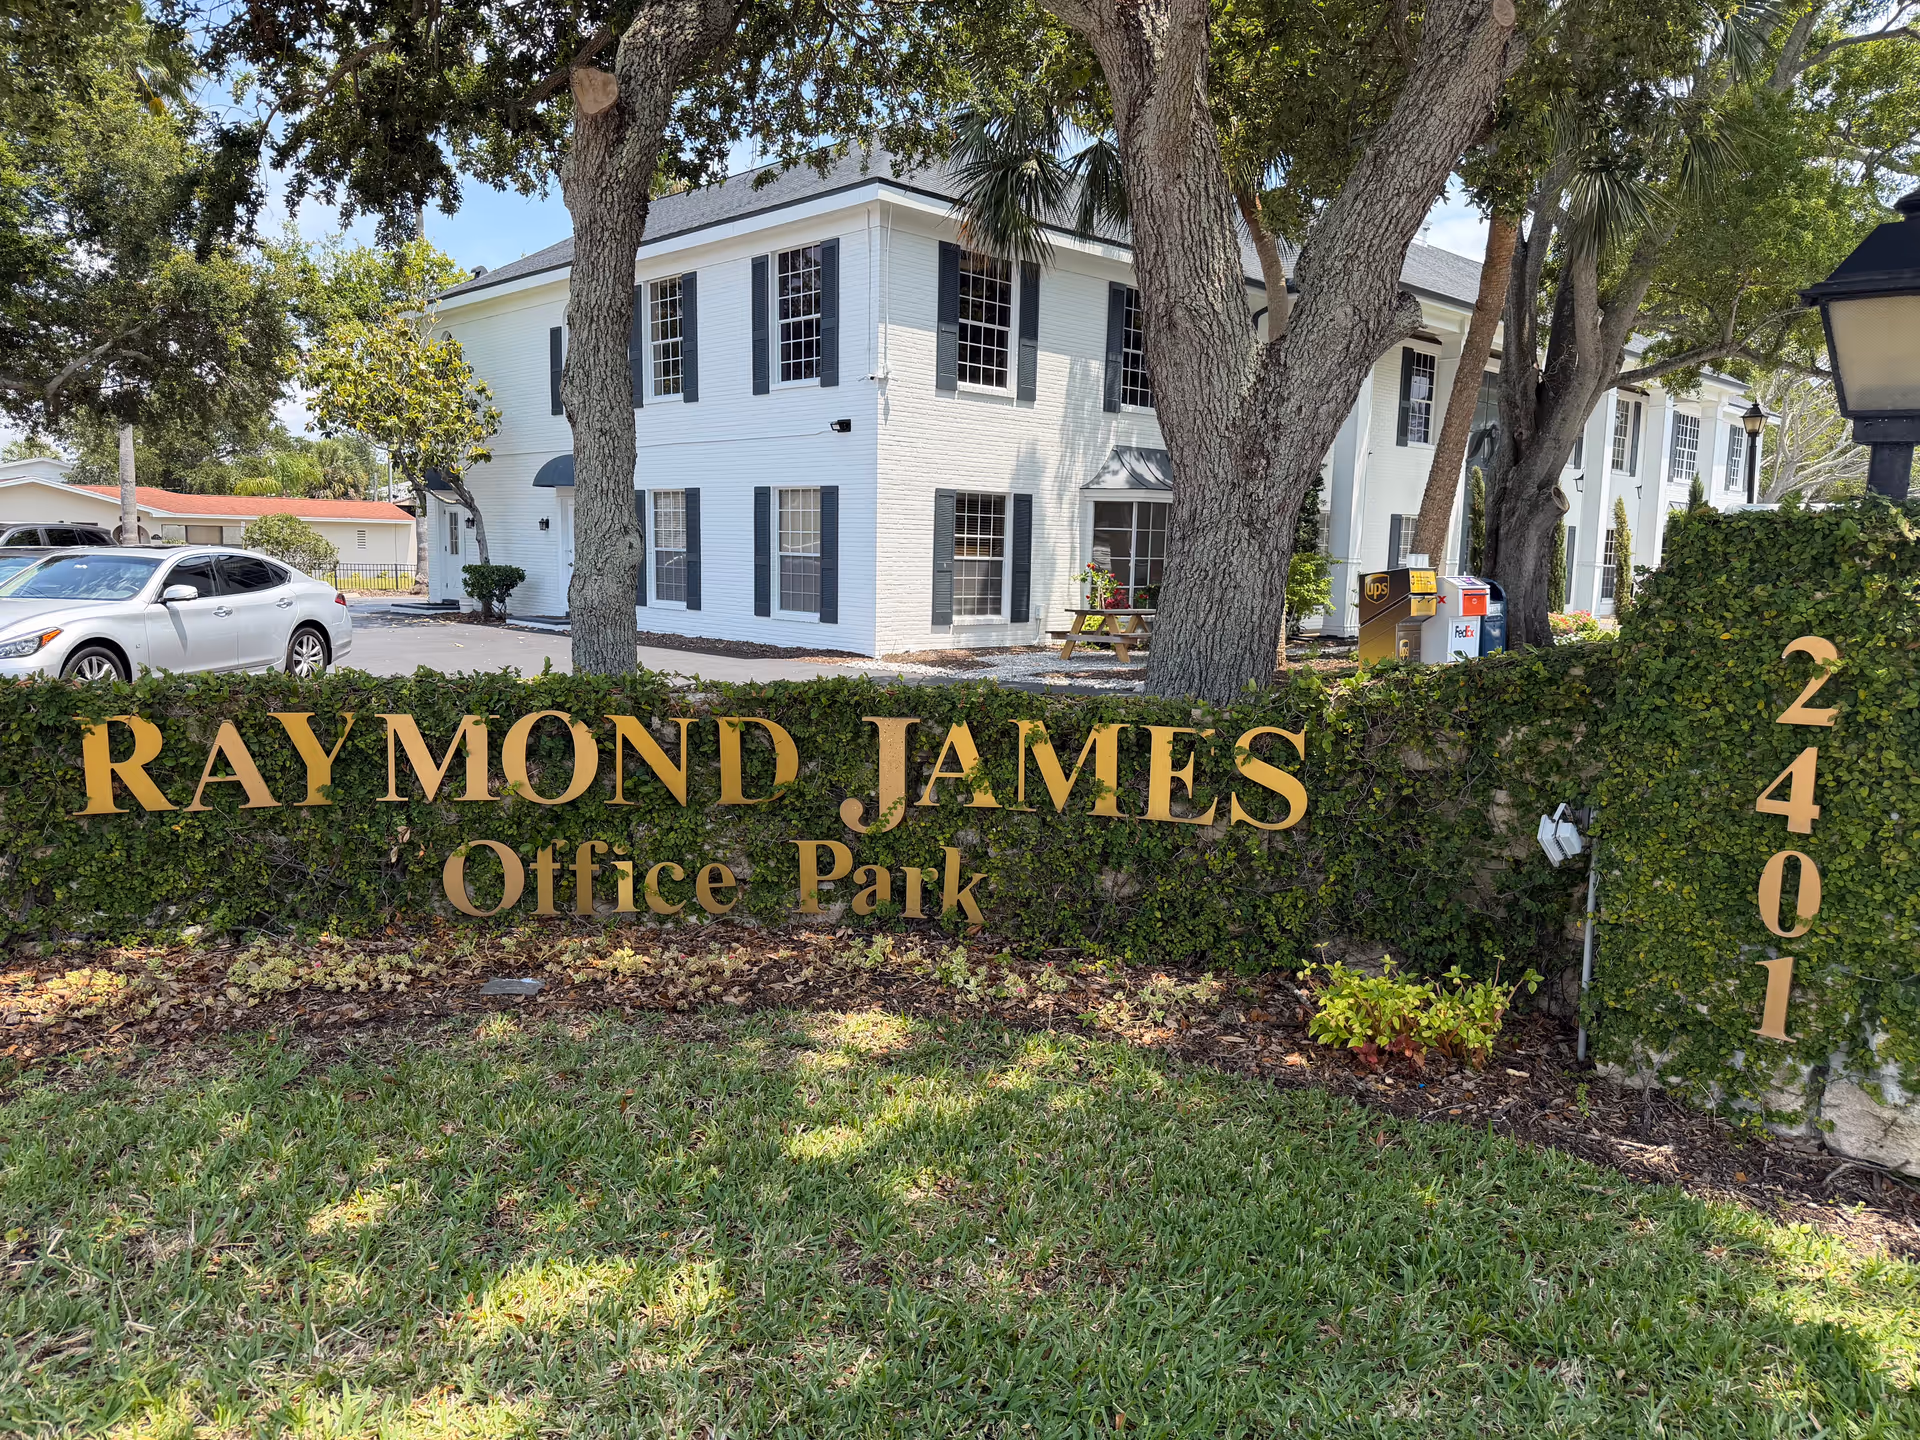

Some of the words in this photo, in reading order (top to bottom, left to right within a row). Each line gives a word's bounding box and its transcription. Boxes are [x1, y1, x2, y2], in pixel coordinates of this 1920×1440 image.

[1367, 583, 1388, 599] ups
[1455, 625, 1475, 638] FedEx
[73, 710, 799, 815] RAYMOND
[839, 715, 1308, 834] JAMES
[442, 839, 738, 918] Office
[789, 839, 988, 924] Park
